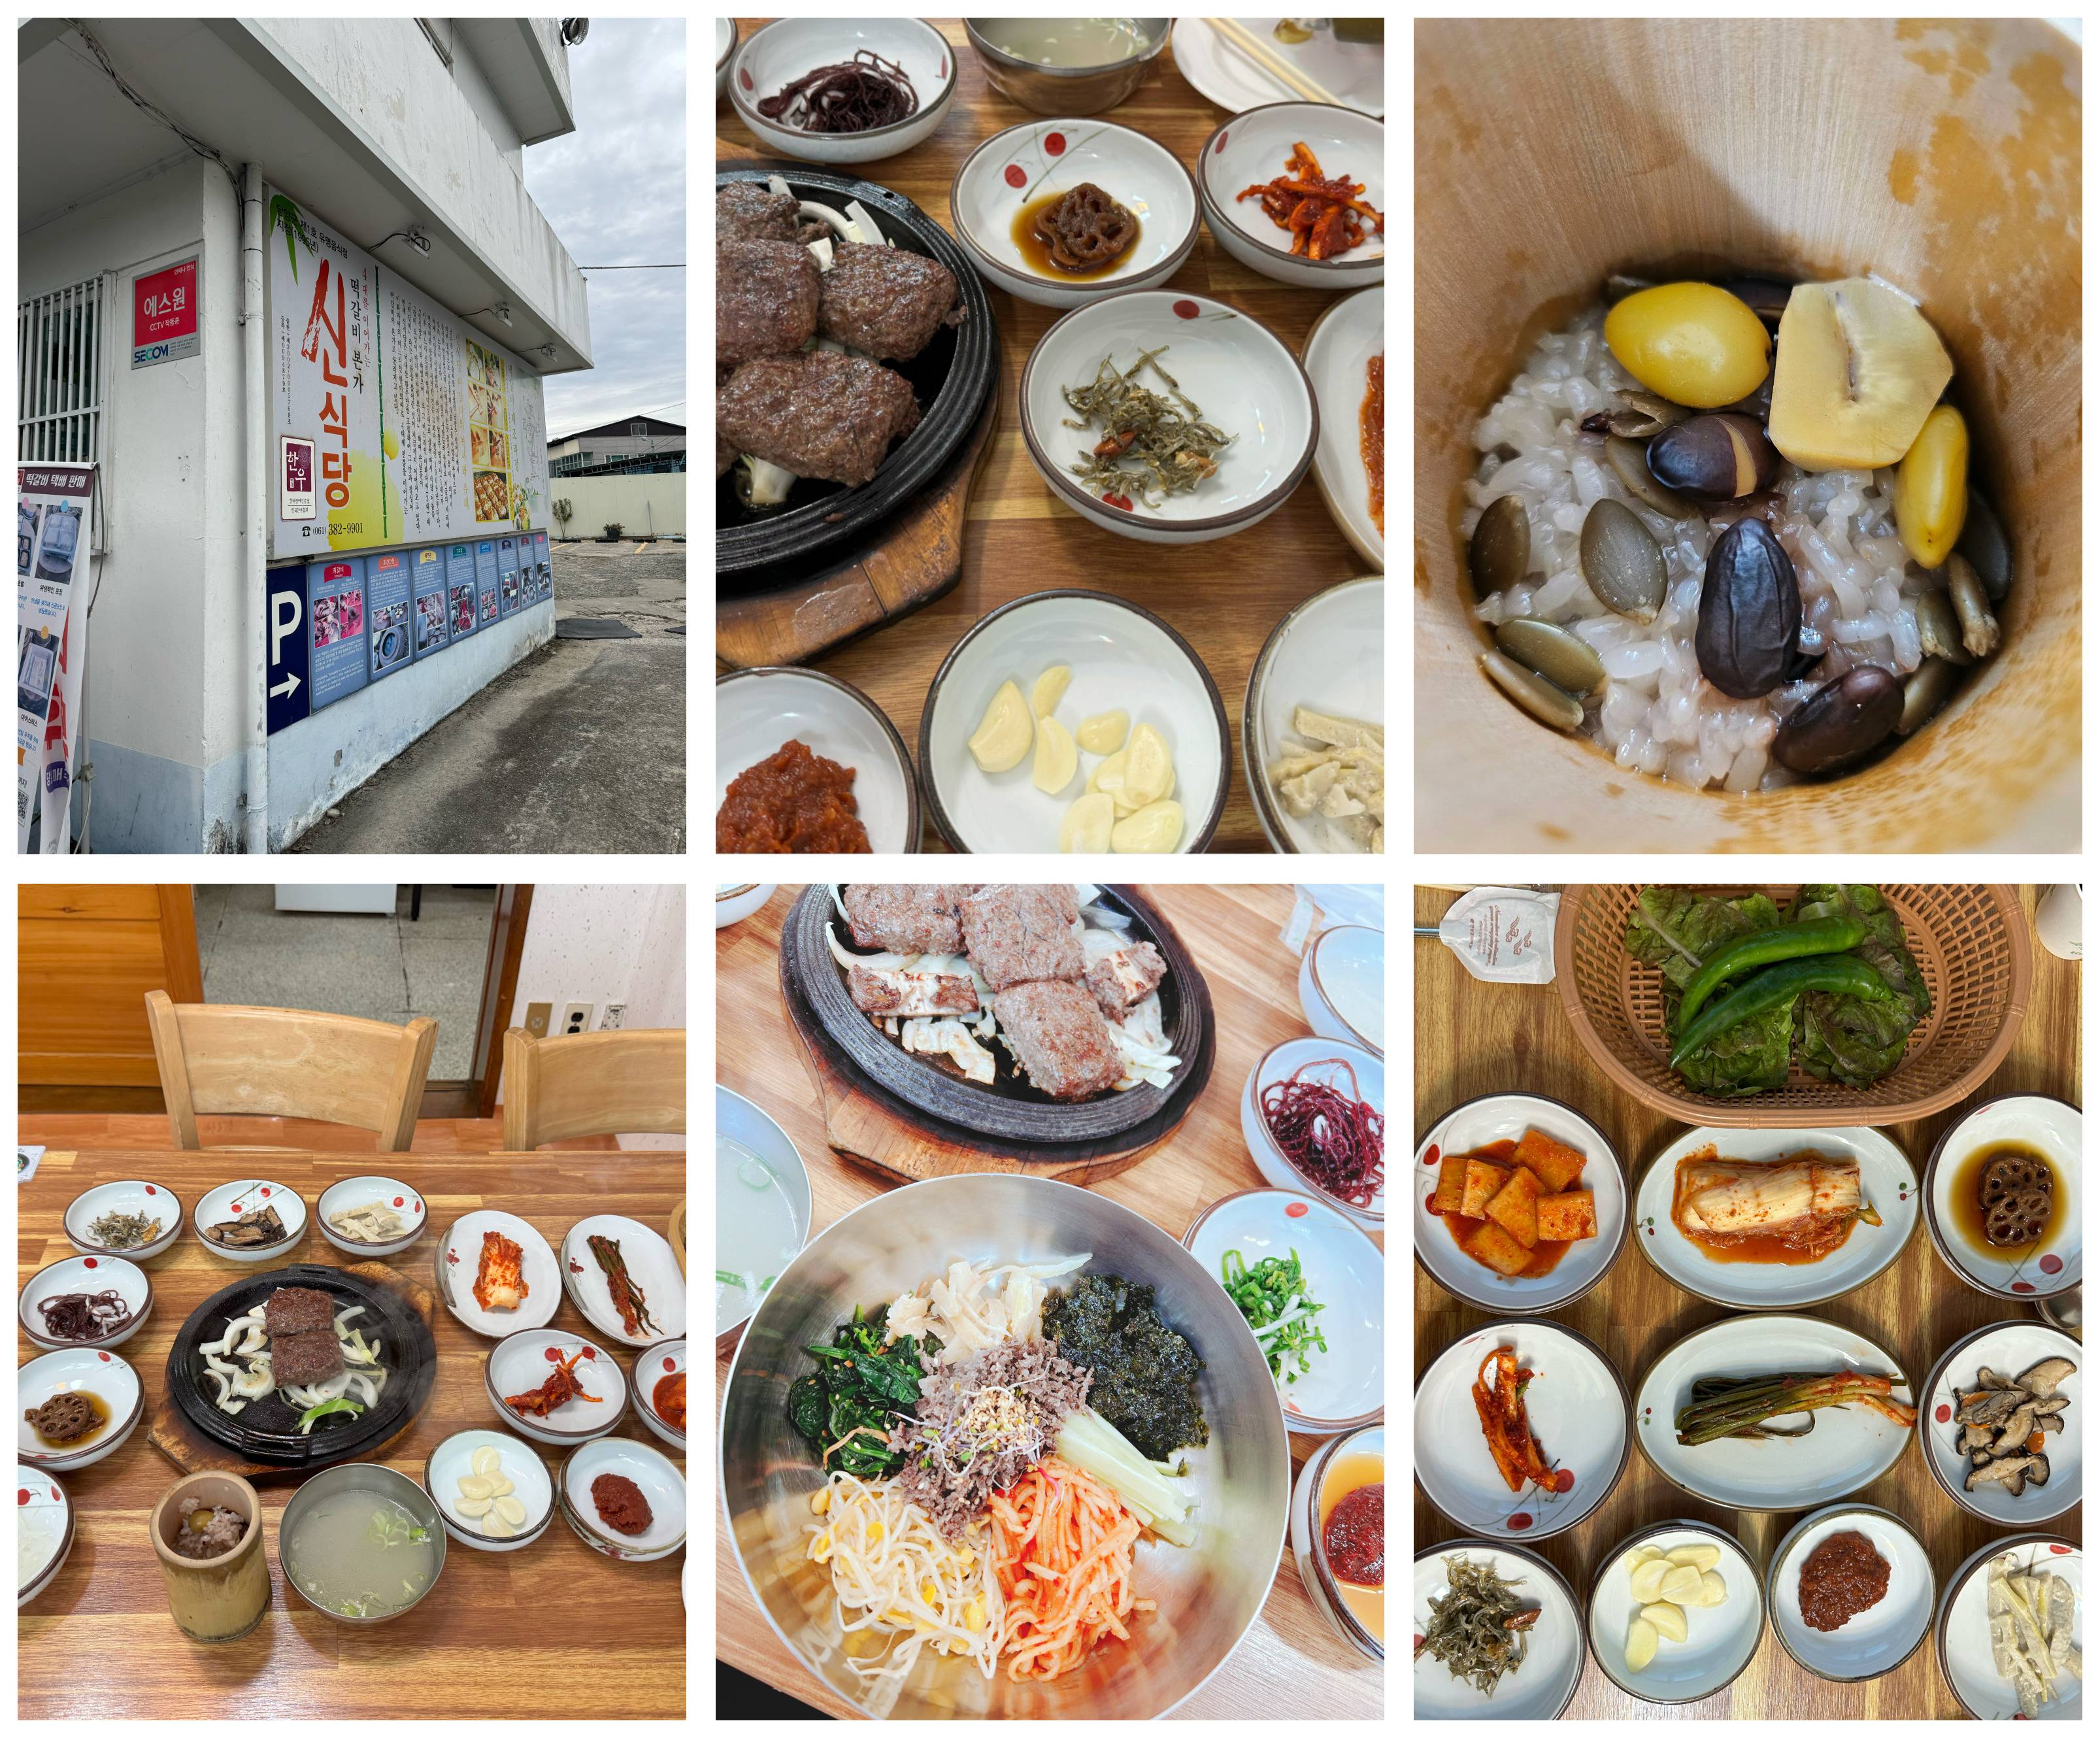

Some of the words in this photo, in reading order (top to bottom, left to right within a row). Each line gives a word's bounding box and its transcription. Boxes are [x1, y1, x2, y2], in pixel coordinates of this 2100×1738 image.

[277, 218, 318, 254] 지정(1995년)
[301, 220, 317, 239] 제1호
[320, 232, 348, 259] 유명음식점
[144, 286, 186, 318] 에스원
[350, 278, 361, 344] 떡갈비
[150, 321, 164, 331] CCTV
[165, 317, 180, 327] 작동중
[134, 344, 169, 363] SECOM
[301, 257, 352, 508] 신식당
[352, 350, 364, 394] 본가
[26, 473, 50, 487] 떡갈비
[50, 475, 67, 487] 택배
[68, 475, 87, 488] 판매
[286, 451, 307, 492] 한우
[312, 526, 326, 535] (061)
[328, 523, 363, 535] 382-9901
[332, 565, 344, 574] 떡갈비
[40, 584, 55, 594] 위생적인
[272, 590, 302, 667] P
